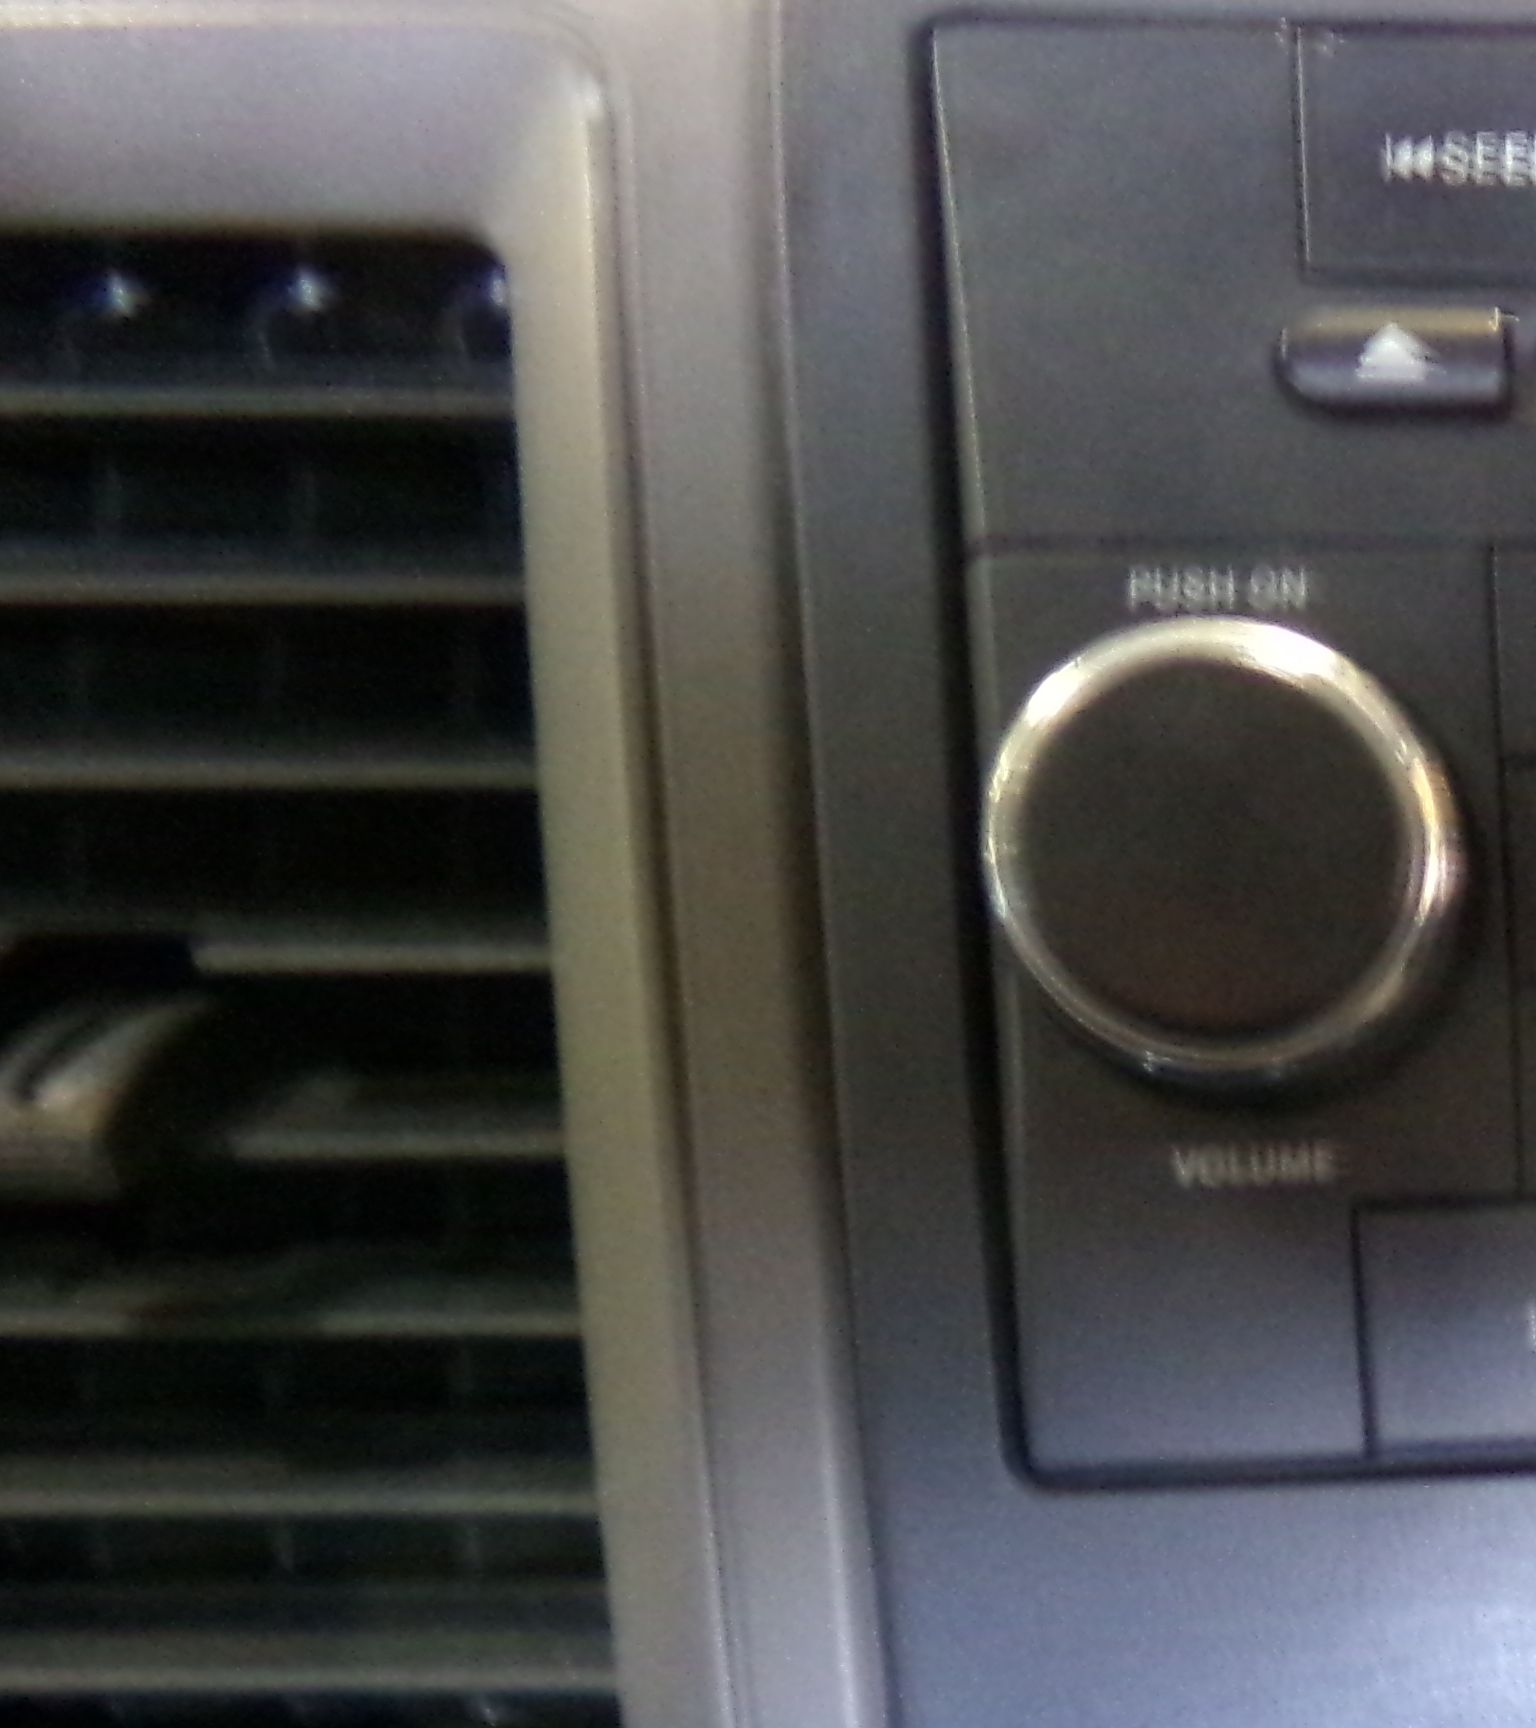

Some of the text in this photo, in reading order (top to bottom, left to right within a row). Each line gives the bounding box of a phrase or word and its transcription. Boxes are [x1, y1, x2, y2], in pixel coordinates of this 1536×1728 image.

[1127, 565, 1308, 612] PUSH ON
[1168, 1143, 1336, 1191] VOLUME
